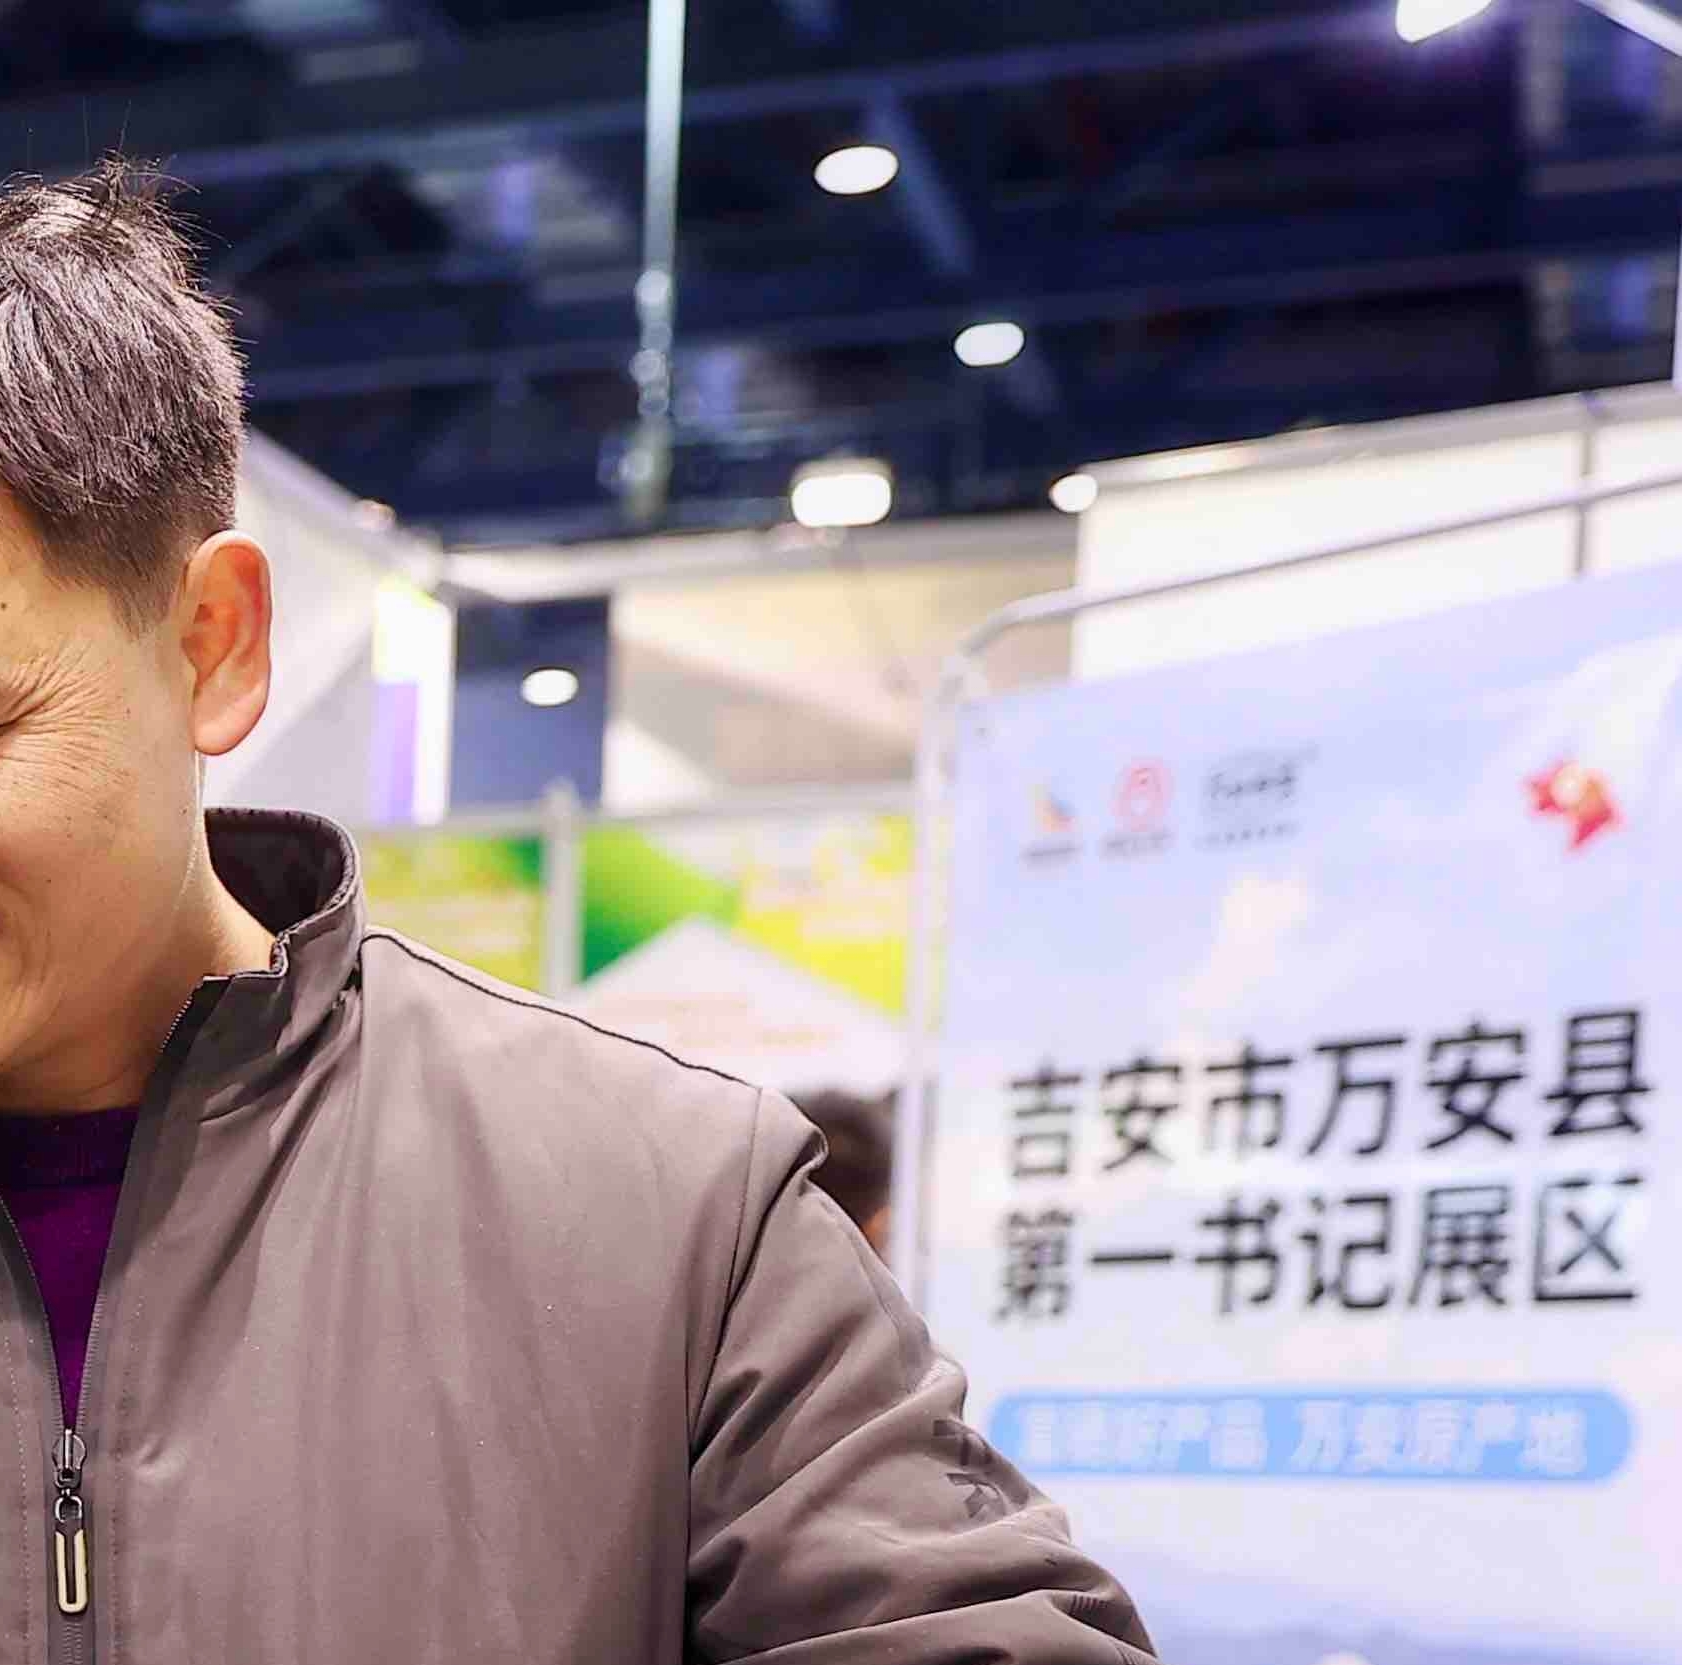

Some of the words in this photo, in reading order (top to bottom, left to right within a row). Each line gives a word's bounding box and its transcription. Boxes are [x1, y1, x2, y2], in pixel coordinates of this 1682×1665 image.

[1008, 1006, 1652, 1179] 吉安市万安县
[995, 1175, 1645, 1318] 第一书记展区
